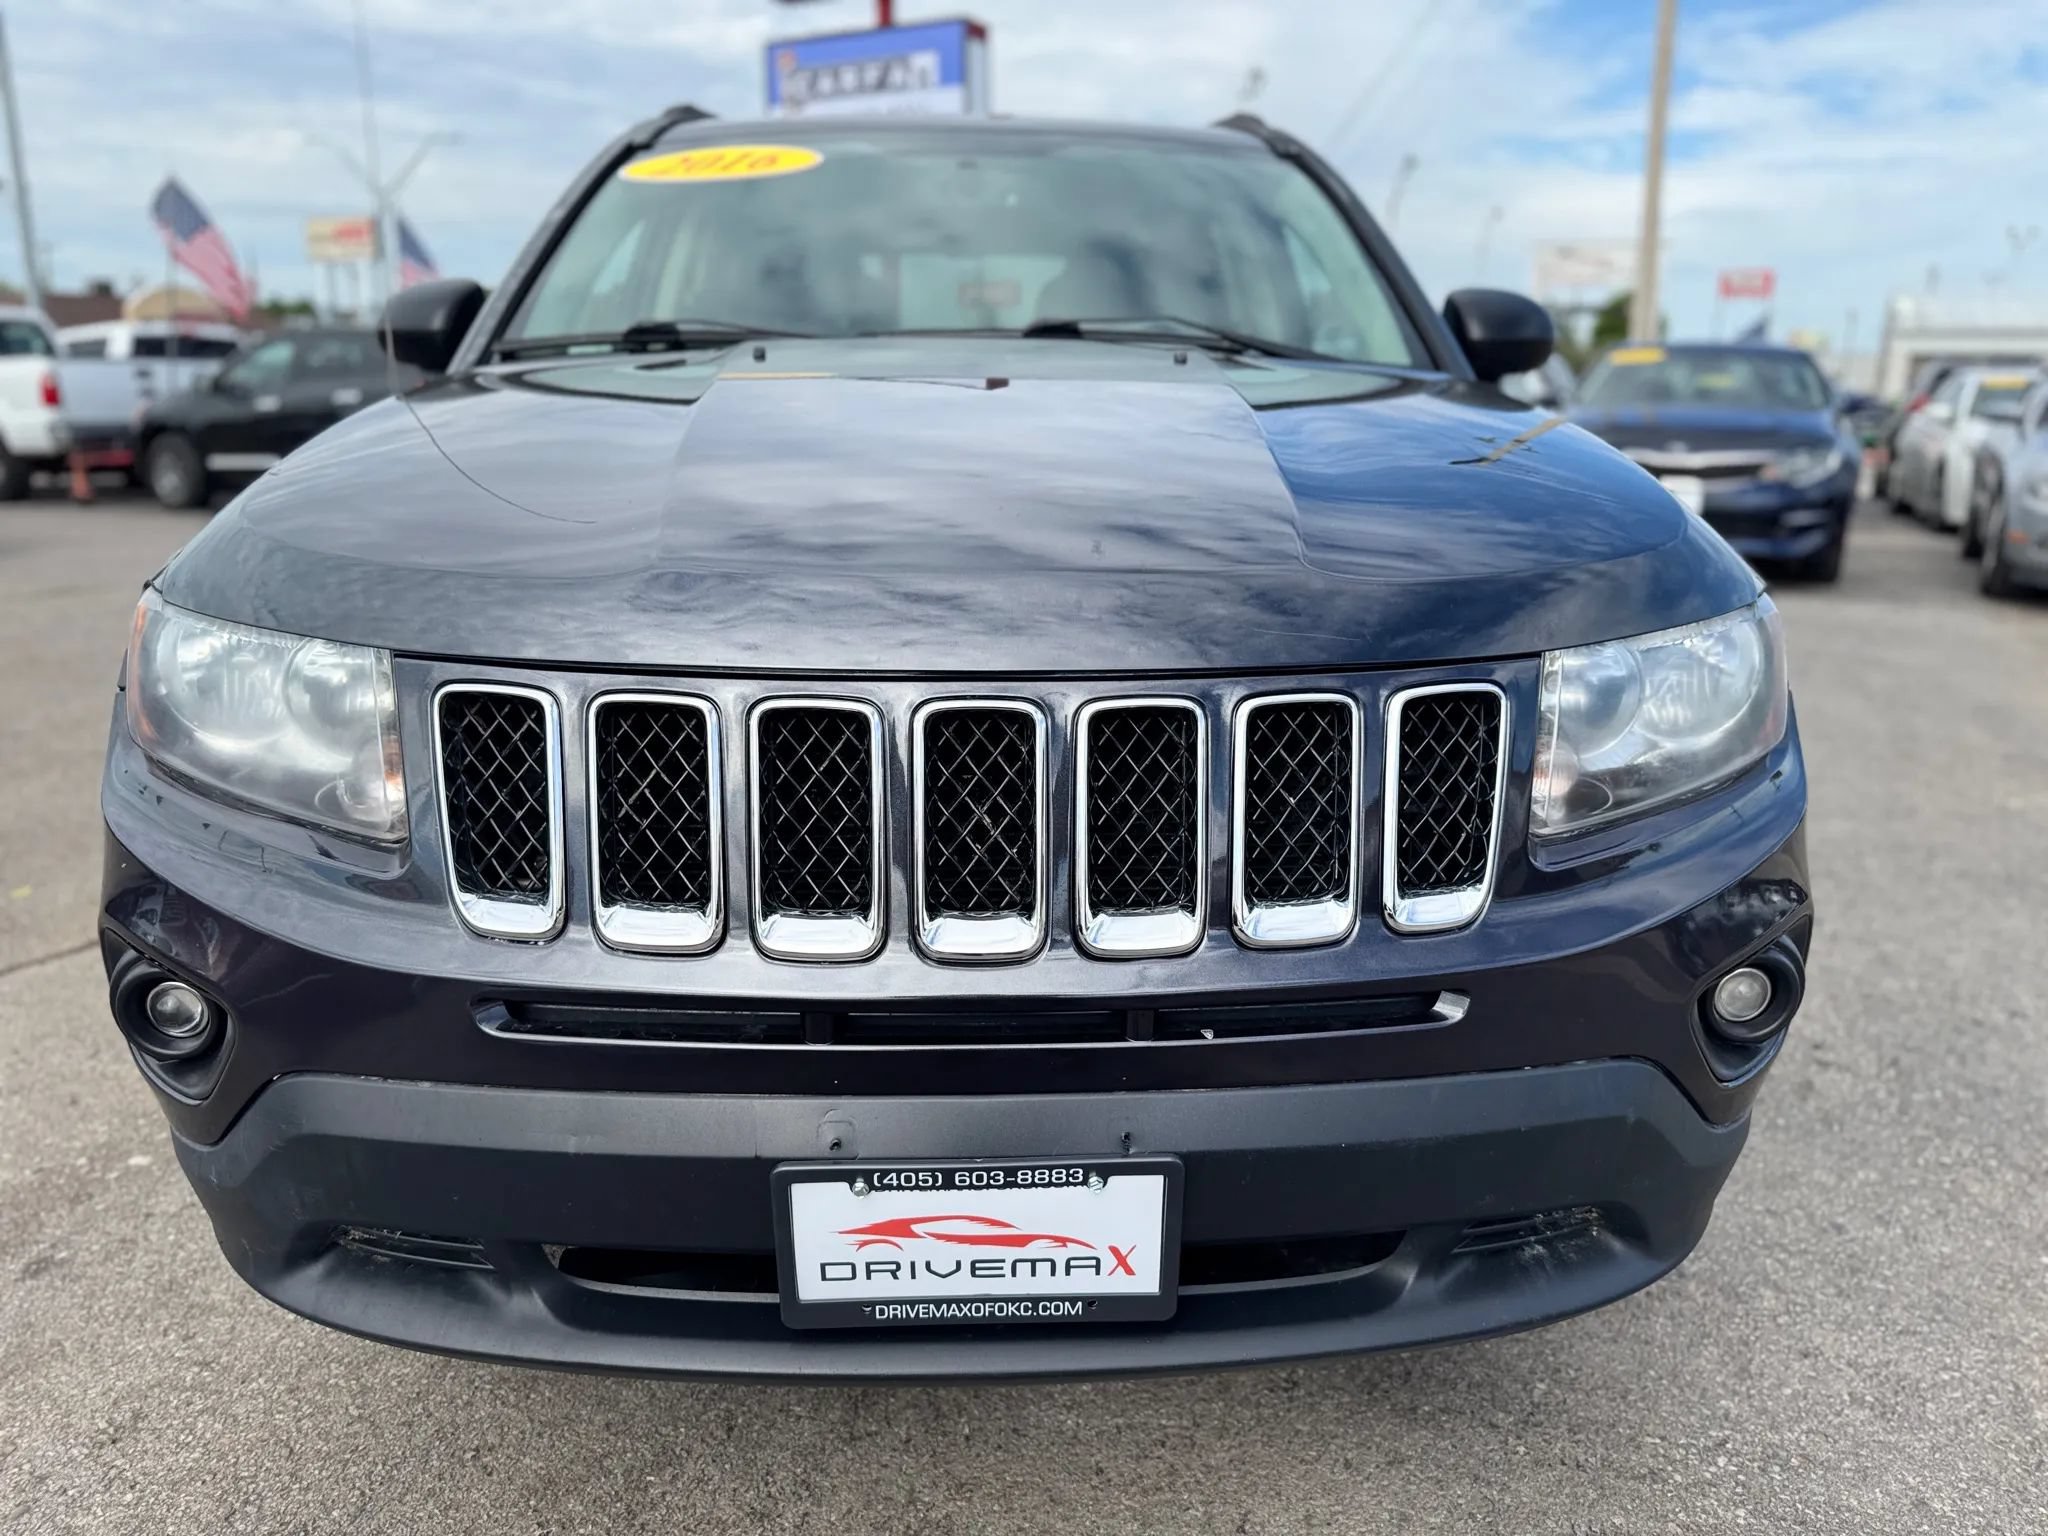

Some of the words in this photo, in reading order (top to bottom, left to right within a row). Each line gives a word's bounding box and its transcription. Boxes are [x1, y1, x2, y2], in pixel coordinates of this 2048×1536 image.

[652, 151, 779, 178] 2016
[873, 1171, 943, 1187] (405)
[954, 1168, 1084, 1186] 603-8883
[819, 1244, 1137, 1282] DRIVEMAX
[875, 1301, 1083, 1320] DRIVEMAXOFOKC.COM
